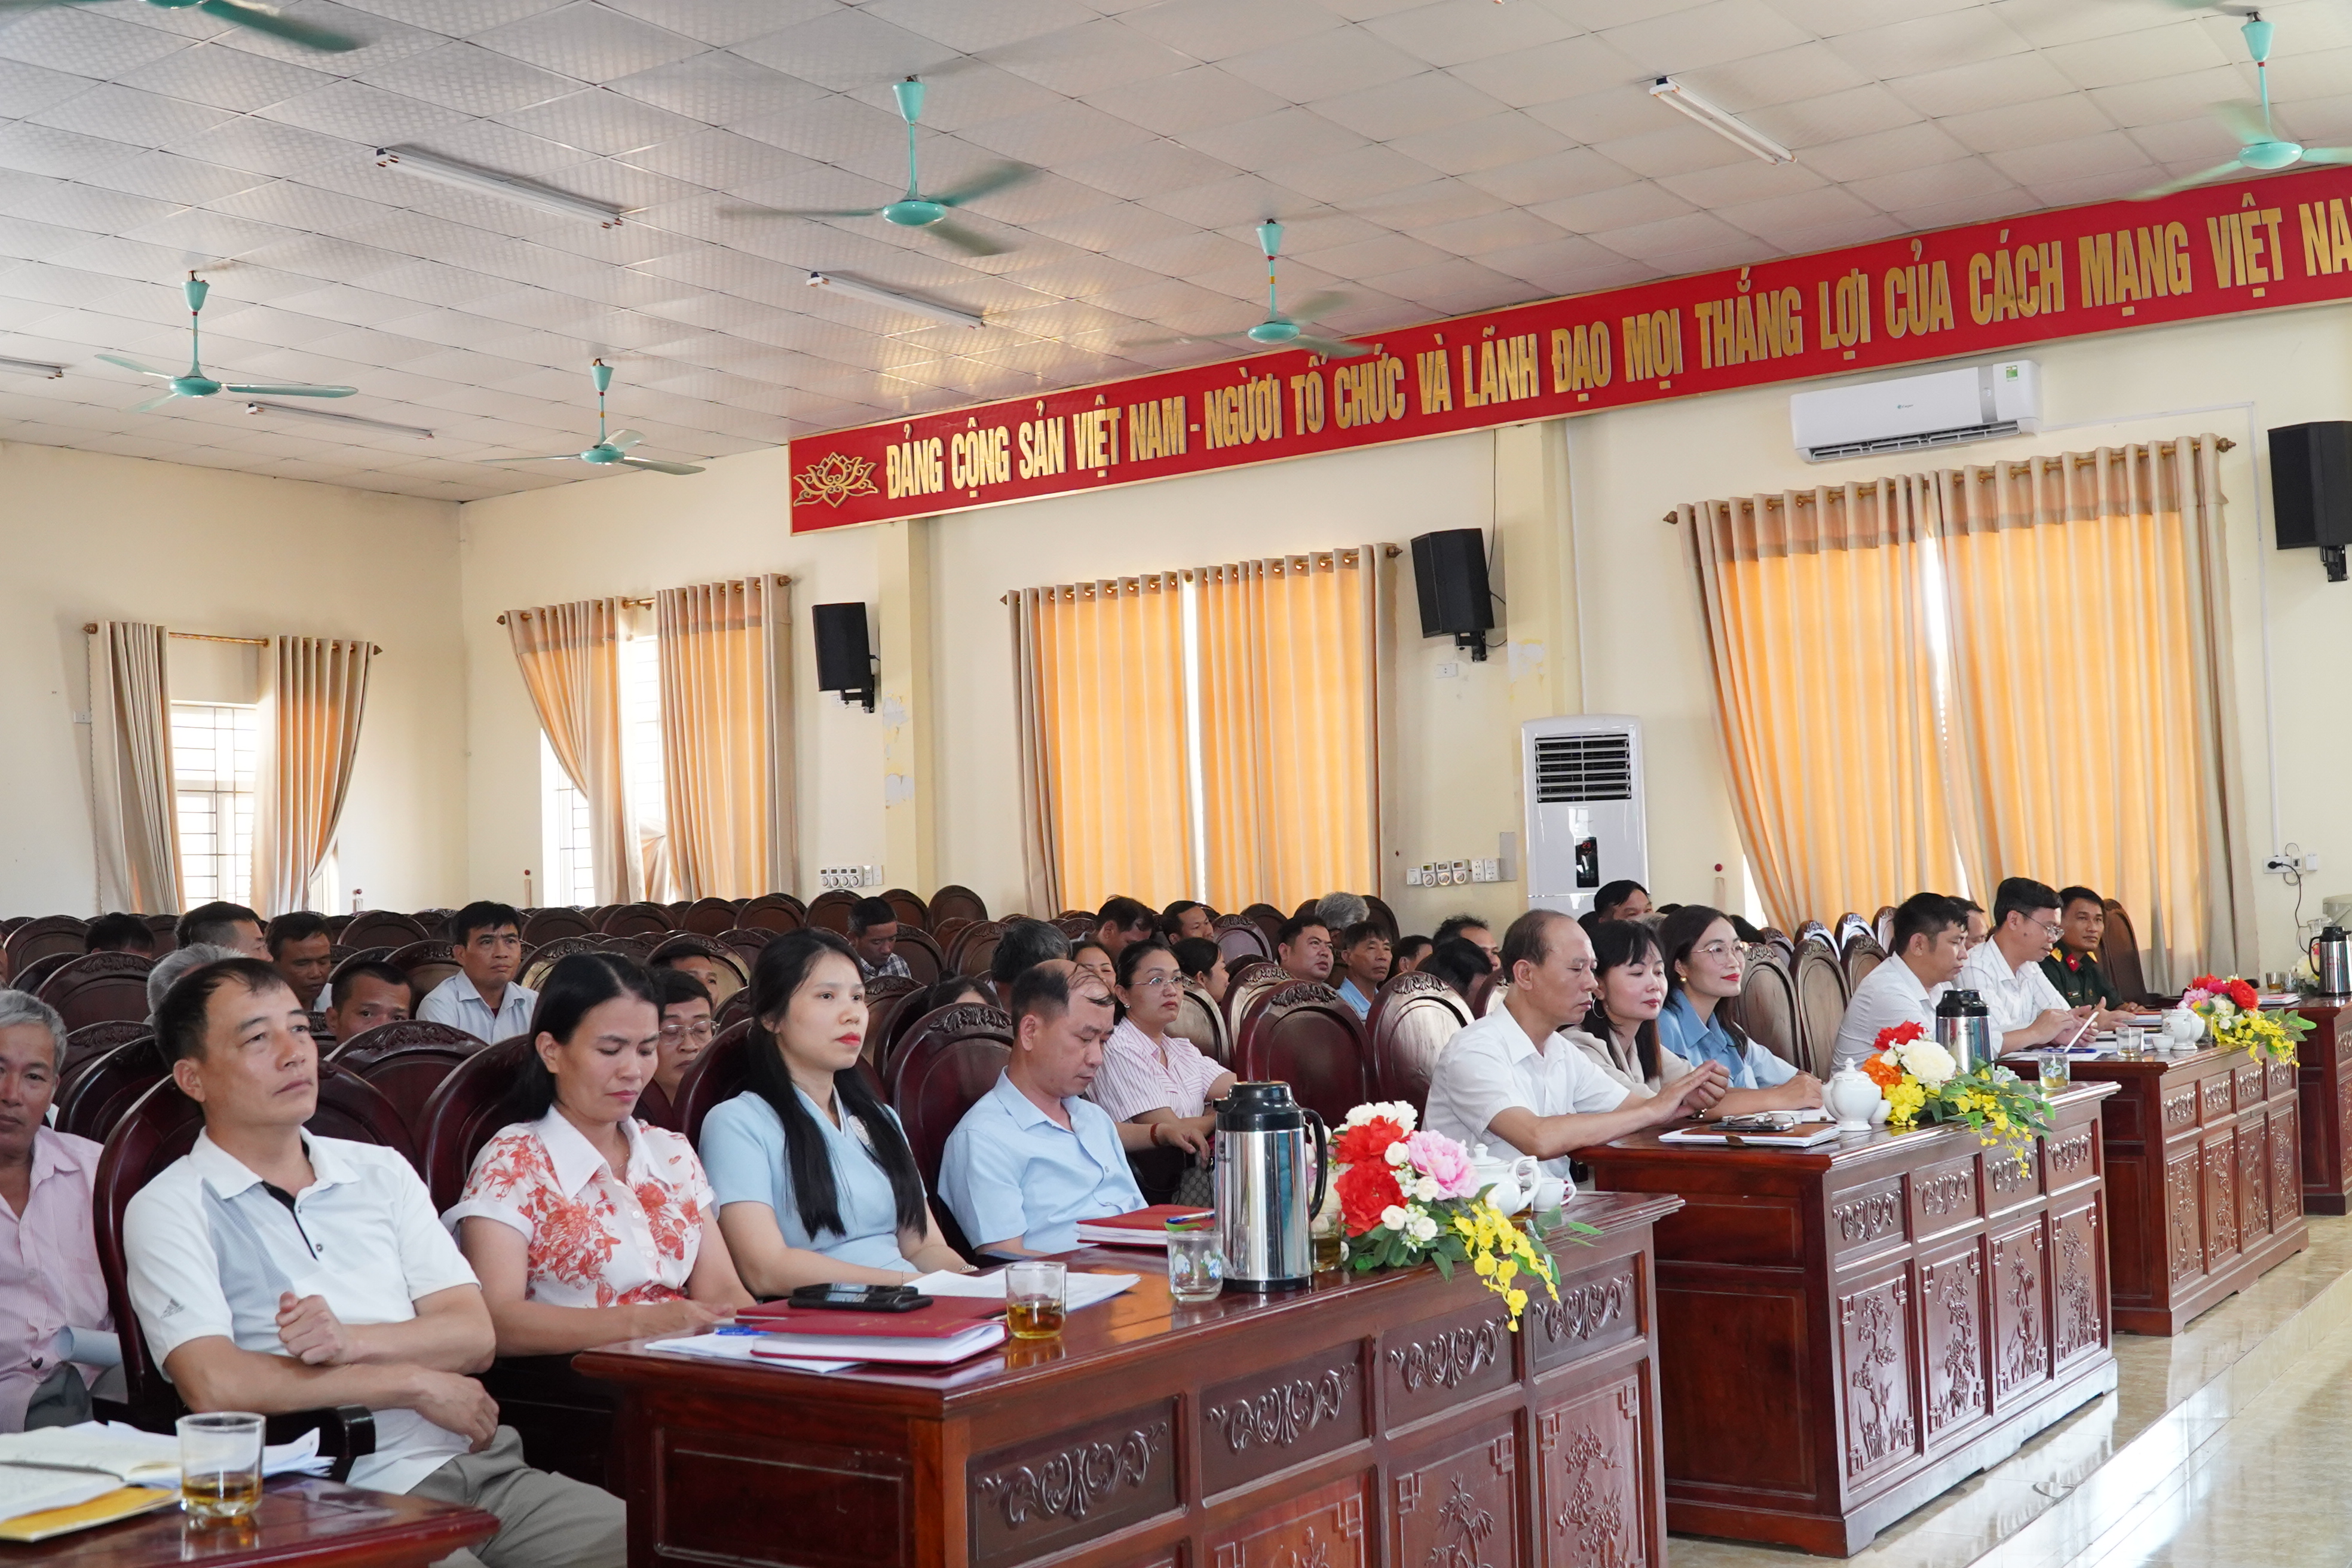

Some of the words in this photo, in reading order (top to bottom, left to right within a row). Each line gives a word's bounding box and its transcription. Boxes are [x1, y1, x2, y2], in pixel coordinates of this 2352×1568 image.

[887, 424, 944, 499] ĐẢNG
[951, 418, 1011, 497] CỘNG
[1019, 400, 1067, 479] SẢN
[1073, 395, 1120, 477] VIỆT
[1129, 396, 1187, 462] NAM
[1204, 366, 1282, 449] NGƯỜI
[1291, 354, 1329, 435] TỔ
[1334, 344, 1405, 429] CHỨC
[1416, 333, 1452, 415] VÀ
[1462, 325, 1540, 408] LÃNH
[1551, 321, 1612, 402] ĐẠO
[1622, 308, 1683, 390] MỌI
[1695, 267, 1803, 369] THẮNG
[1818, 268, 1871, 360] LỢI
[1884, 238, 1955, 339] CỦA
[1969, 228, 2065, 325] CÁCH
[2078, 221, 2192, 317] MẠNG
[2206, 192, 2284, 298] VIỆT
[2298, 197, 2352, 277] NA
